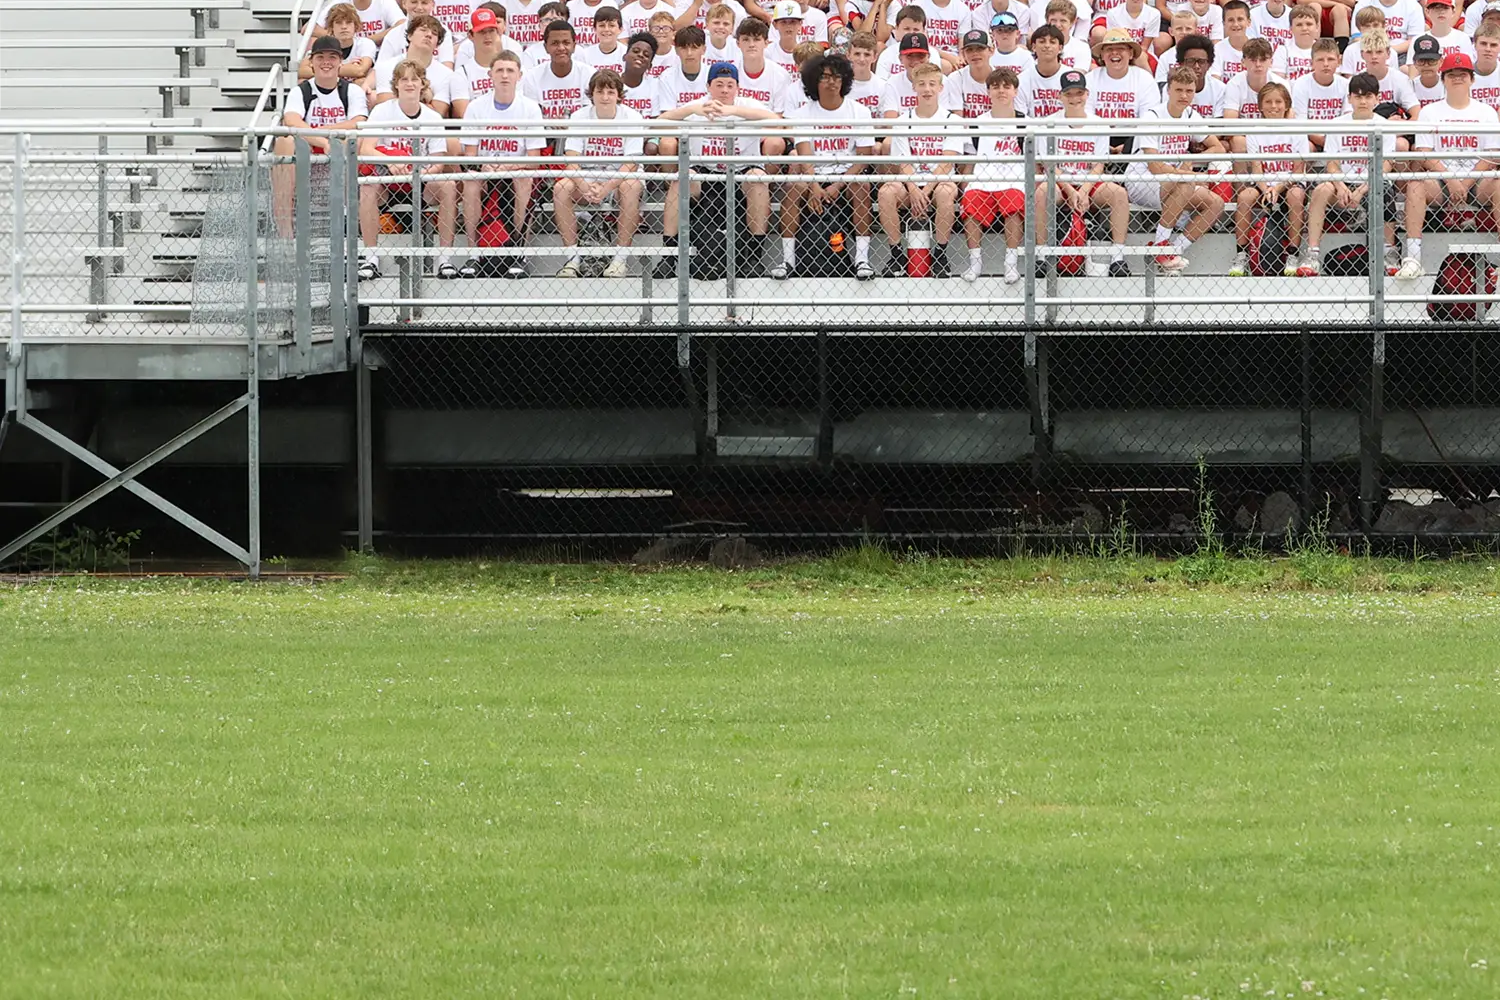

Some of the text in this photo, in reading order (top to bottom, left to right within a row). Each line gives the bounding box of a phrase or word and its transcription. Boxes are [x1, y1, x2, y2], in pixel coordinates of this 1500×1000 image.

[432, 5, 469, 15] LEGENDS
[508, 14, 539, 24] LEGEND
[1223, 62, 1246, 71] LEGEN
[542, 88, 580, 99] LEGENDS
[1097, 92, 1135, 102] LEGENDS
[1308, 99, 1343, 108] LEGENDS
[1095, 109, 1135, 118] MAKING
[481, 139, 518, 151] MAKING
[1058, 140, 1095, 152] LEGENDS
[1341, 136, 1368, 146] LEGEN
[1441, 136, 1478, 148] MAKING
